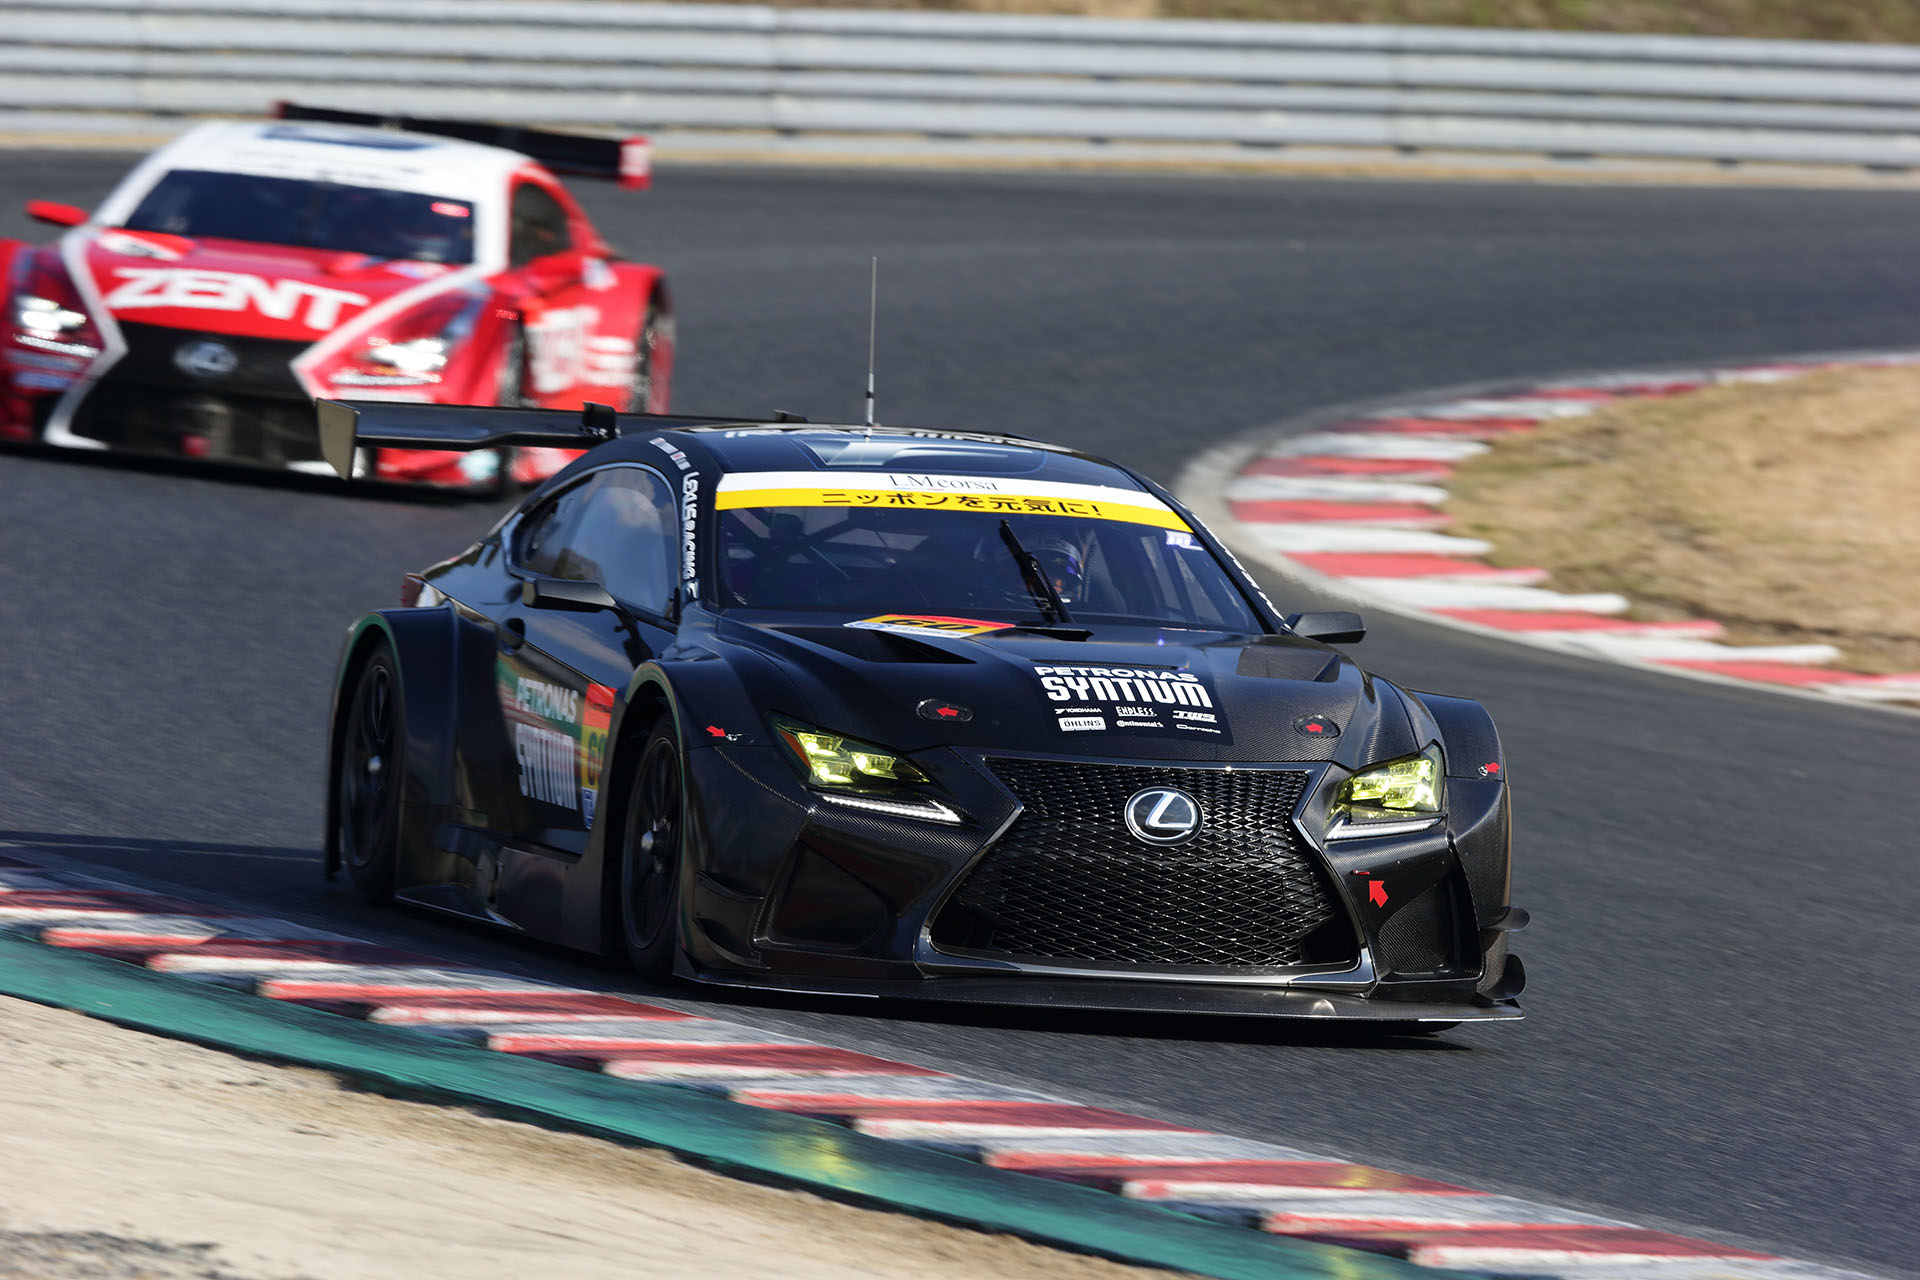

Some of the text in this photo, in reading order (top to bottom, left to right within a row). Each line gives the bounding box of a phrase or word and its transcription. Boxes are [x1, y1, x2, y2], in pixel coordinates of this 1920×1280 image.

[106, 267, 371, 331] ZENT
[681, 471, 700, 522] LEXUS
[1034, 667, 1198, 682] PETRONAS
[1041, 677, 1213, 708] SYNTIUM
[517, 677, 578, 723] PETRONAS
[1063, 718, 1102, 728] ÖHLINS
